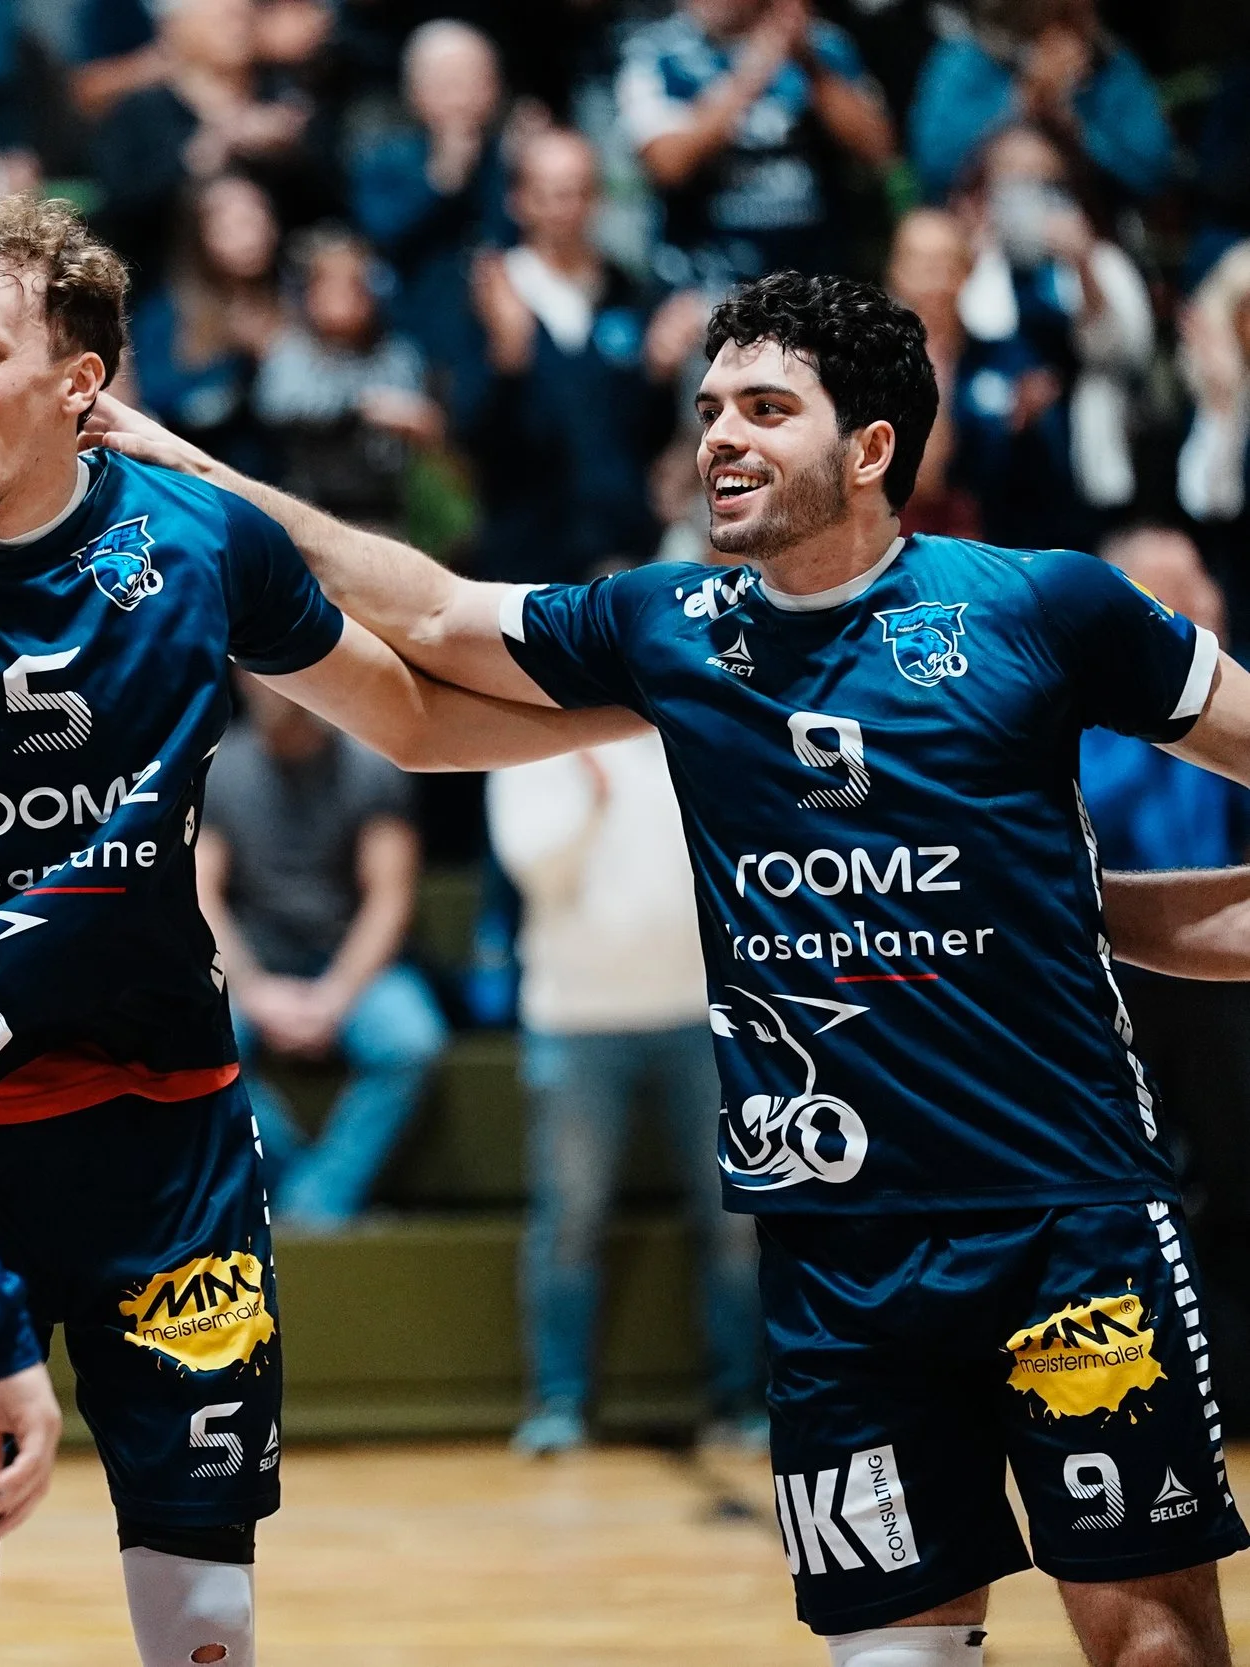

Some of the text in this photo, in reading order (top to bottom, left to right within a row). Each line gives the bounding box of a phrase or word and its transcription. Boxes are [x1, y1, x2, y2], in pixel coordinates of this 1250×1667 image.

[2, 646, 93, 754] 5
[705, 656, 755, 678] SELECT
[787, 711, 871, 809] 9
[725, 920, 994, 967] kosaplaner
[141, 1264, 261, 1323] MM
[1019, 1344, 1144, 1373] meistermaler
[189, 1401, 243, 1478] 5
[774, 1468, 866, 1575] JK
[868, 1455, 906, 1562] CONSULTING
[1063, 1452, 1125, 1530] 9
[1150, 1499, 1198, 1523] SELECT
